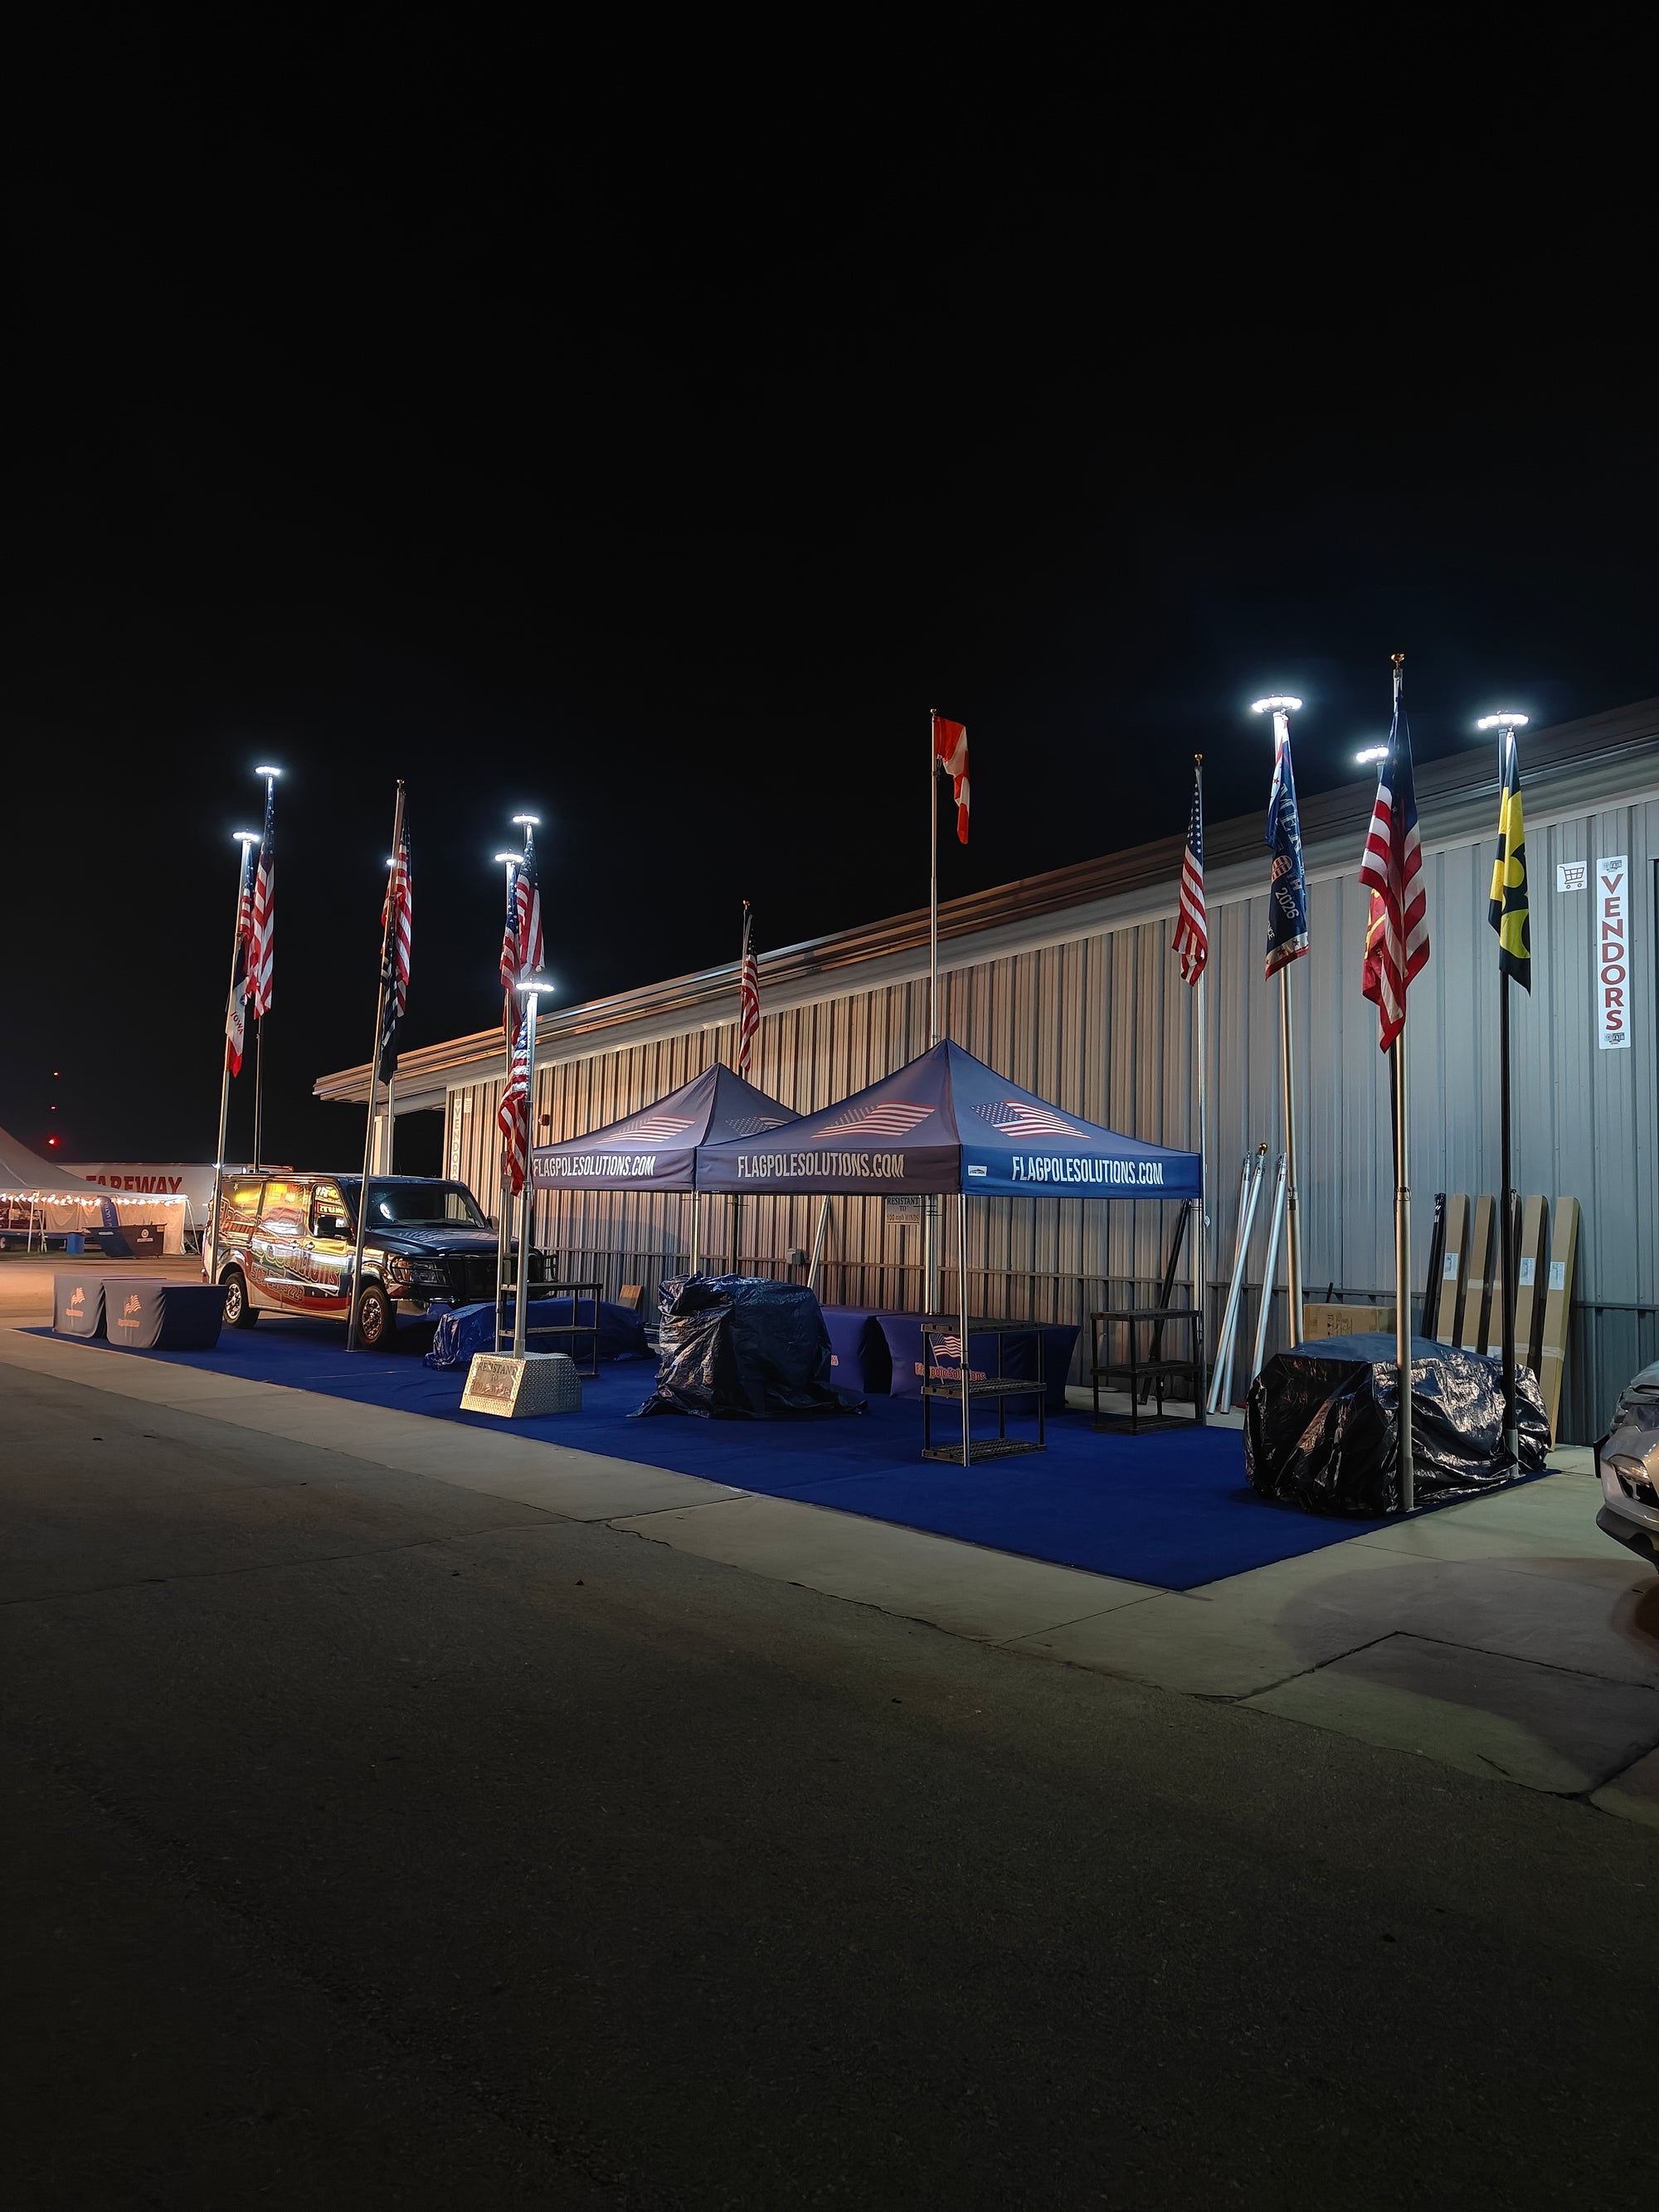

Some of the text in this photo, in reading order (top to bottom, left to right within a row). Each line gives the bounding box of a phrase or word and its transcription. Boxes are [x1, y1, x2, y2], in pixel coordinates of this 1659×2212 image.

[1275, 887, 1300, 919] 2026
[1600, 873, 1626, 1031] VENDORS
[230, 1011, 244, 1035] IOWA
[533, 1155, 656, 1177] FLAGPOLESOLUTIONS.COM
[737, 1153, 905, 1178] FLAGPOLESOLUTIONS.COM
[1012, 1156, 1164, 1184] FLAGPOLESOLUTIONS.COM
[85, 1175, 182, 1194] AREWAY
[478, 1361, 518, 1376] RESISTANT
